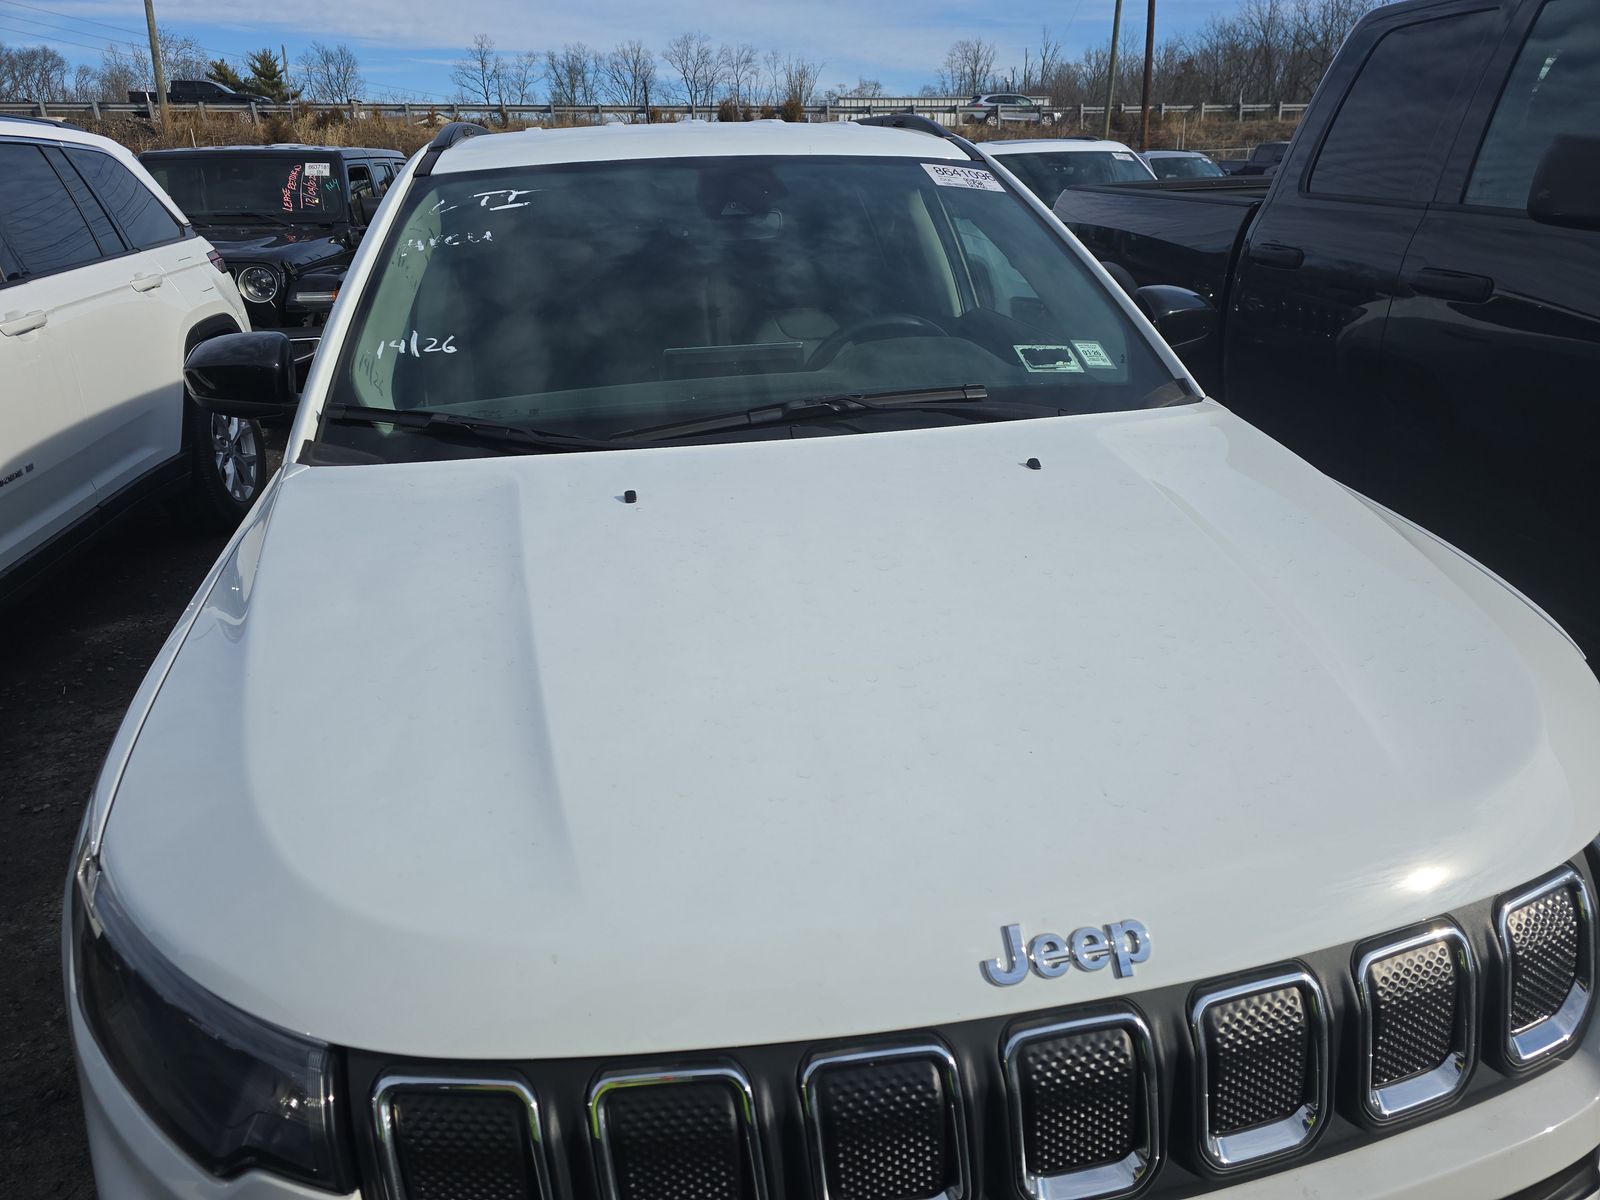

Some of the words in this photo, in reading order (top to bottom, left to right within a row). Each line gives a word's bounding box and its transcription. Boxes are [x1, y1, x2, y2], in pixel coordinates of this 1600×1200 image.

[933, 166, 996, 182] 8641096
[282, 187, 293, 211] LEASE
[979, 919, 1151, 987] Jeep
